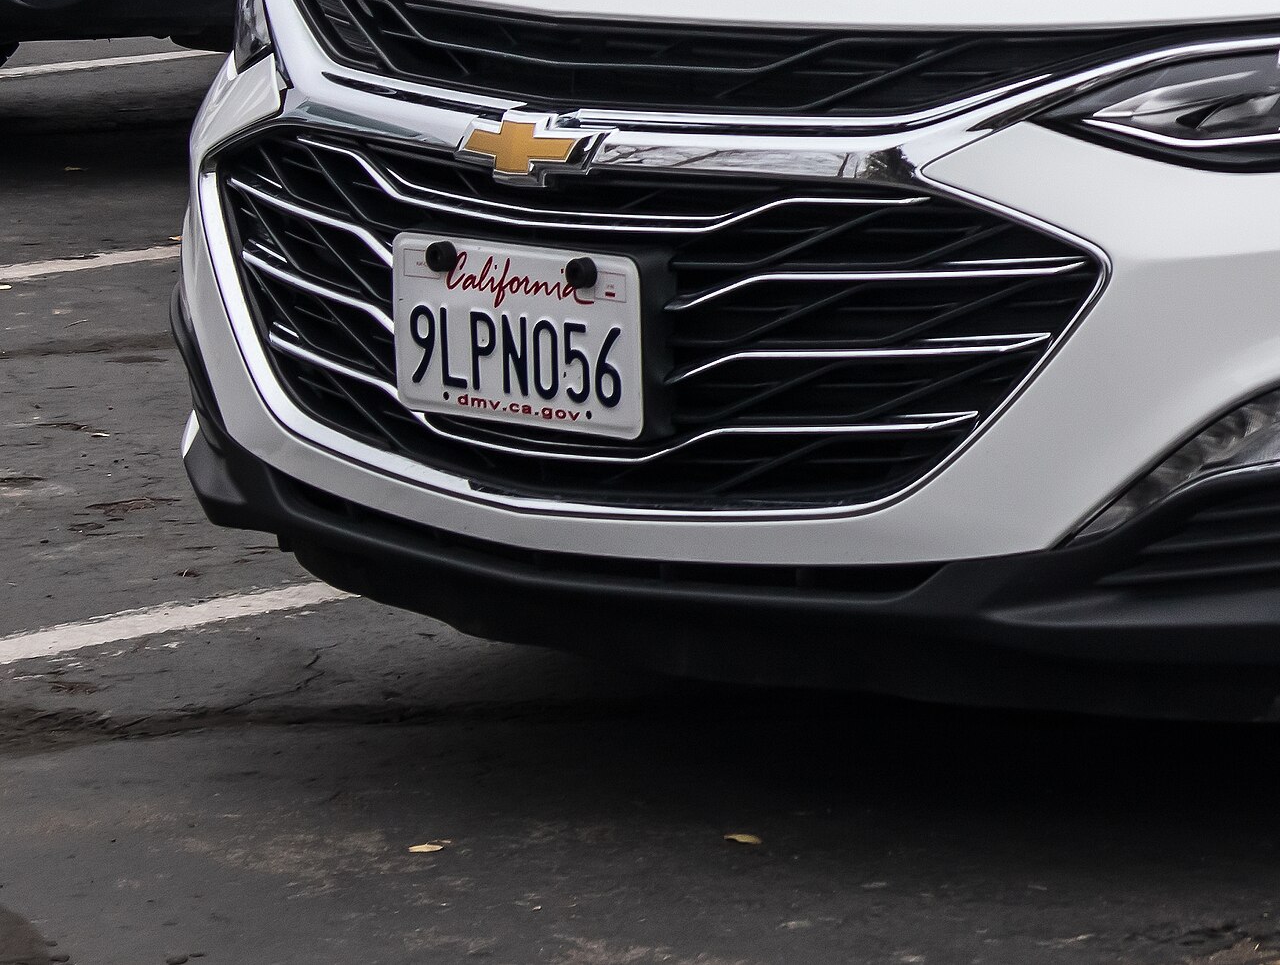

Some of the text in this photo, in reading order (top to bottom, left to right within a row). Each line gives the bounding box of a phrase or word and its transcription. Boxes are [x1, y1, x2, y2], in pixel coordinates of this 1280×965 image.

[446, 251, 595, 308] California
[409, 304, 622, 408] 9LPN056
[457, 392, 580, 421] dmv.ca.gov
